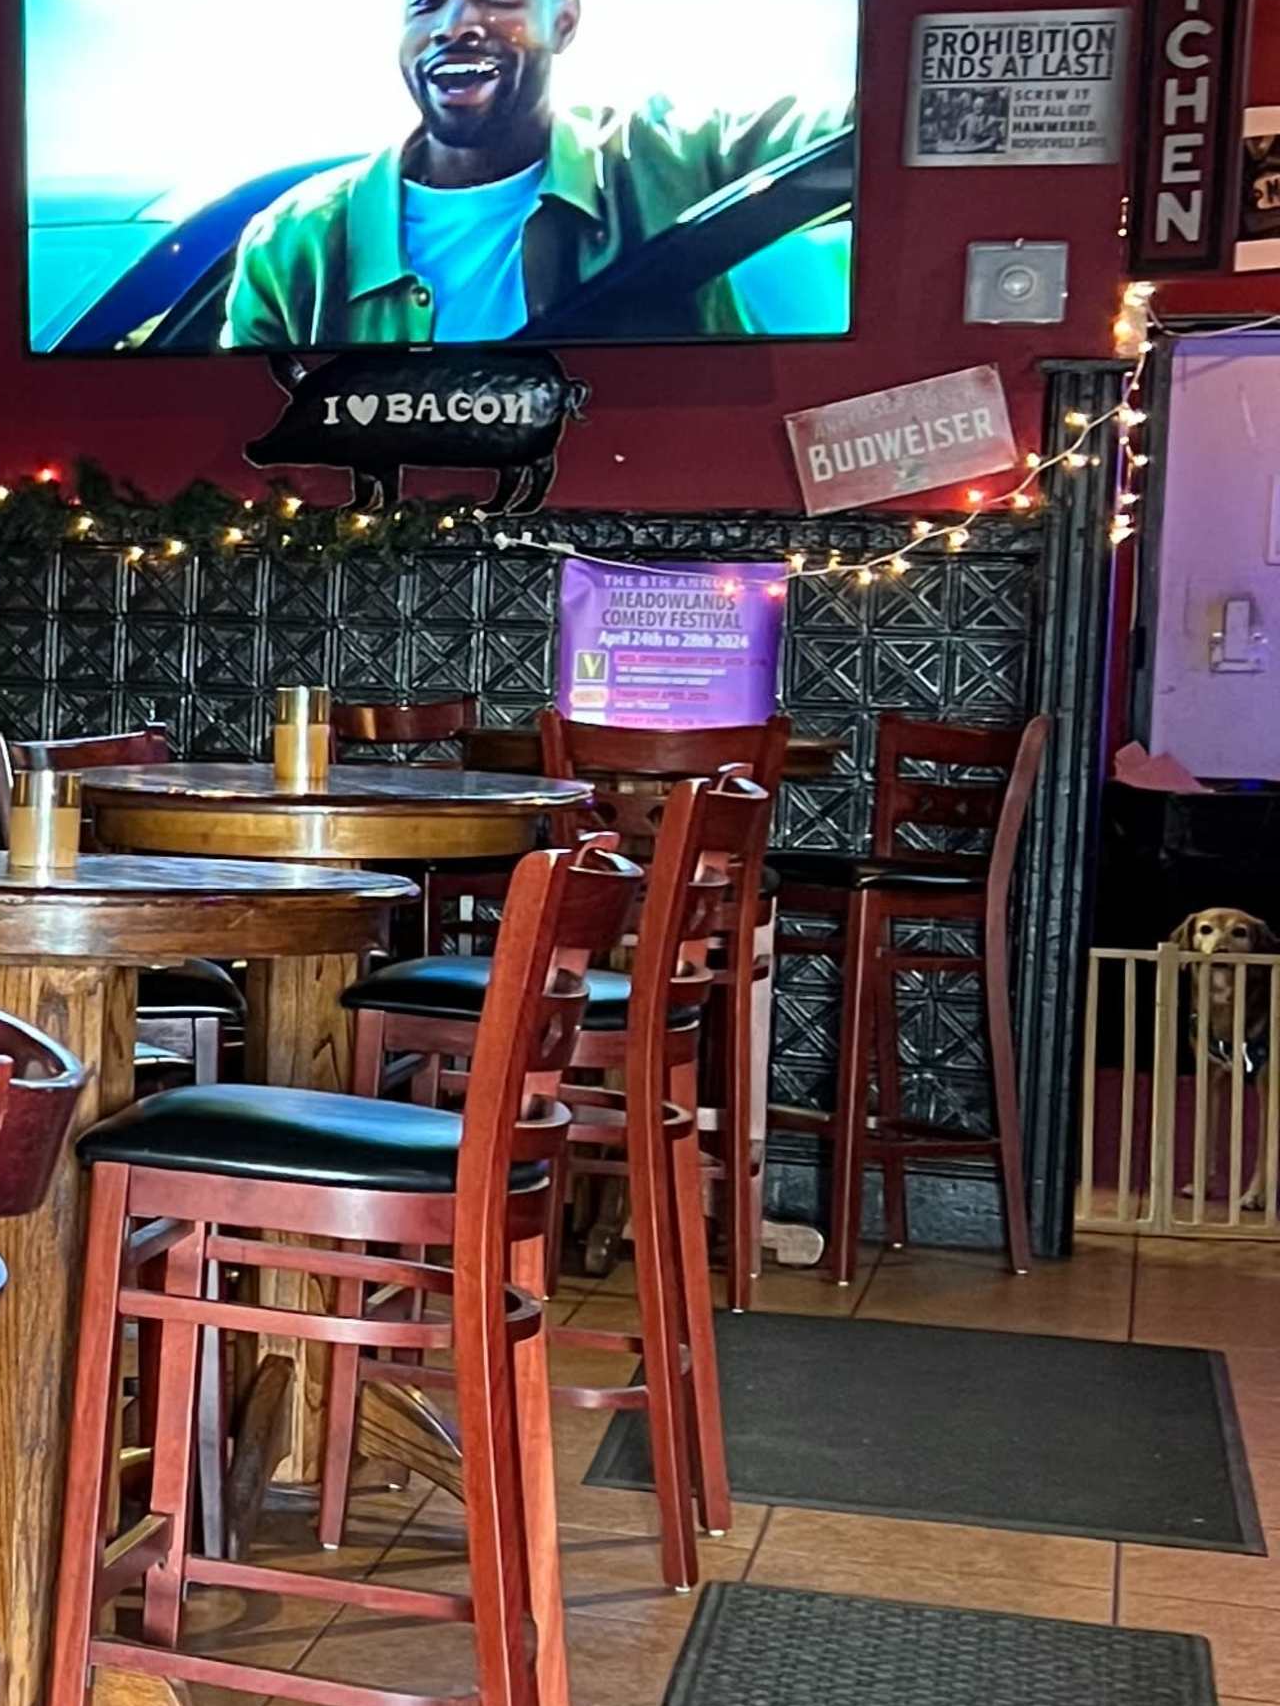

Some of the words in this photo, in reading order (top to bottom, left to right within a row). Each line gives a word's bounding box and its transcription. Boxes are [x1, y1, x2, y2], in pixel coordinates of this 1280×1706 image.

[922, 27, 1116, 56] PROHIBITION
[921, 56, 993, 79] ENDS
[1001, 54, 1033, 77] AT
[1042, 53, 1113, 76] LAST!
[1014, 89, 1068, 101] SCREW
[1074, 88, 1090, 100] IT
[323, 396, 340, 425] I
[385, 393, 533, 424] BACON
[808, 407, 994, 483] BUDWEISER
[604, 575, 634, 587] THE
[675, 575, 730, 589] ANNU
[610, 592, 736, 610] MEADOWLANDS
[601, 609, 666, 627] COMEDY
[670, 611, 742, 629] FESTIVAL
[598, 631, 630, 647] April
[631, 631, 663, 646] 24th
[665, 634, 679, 646] to
[682, 633, 713, 647] 28th
[715, 634, 750, 648] 2024
